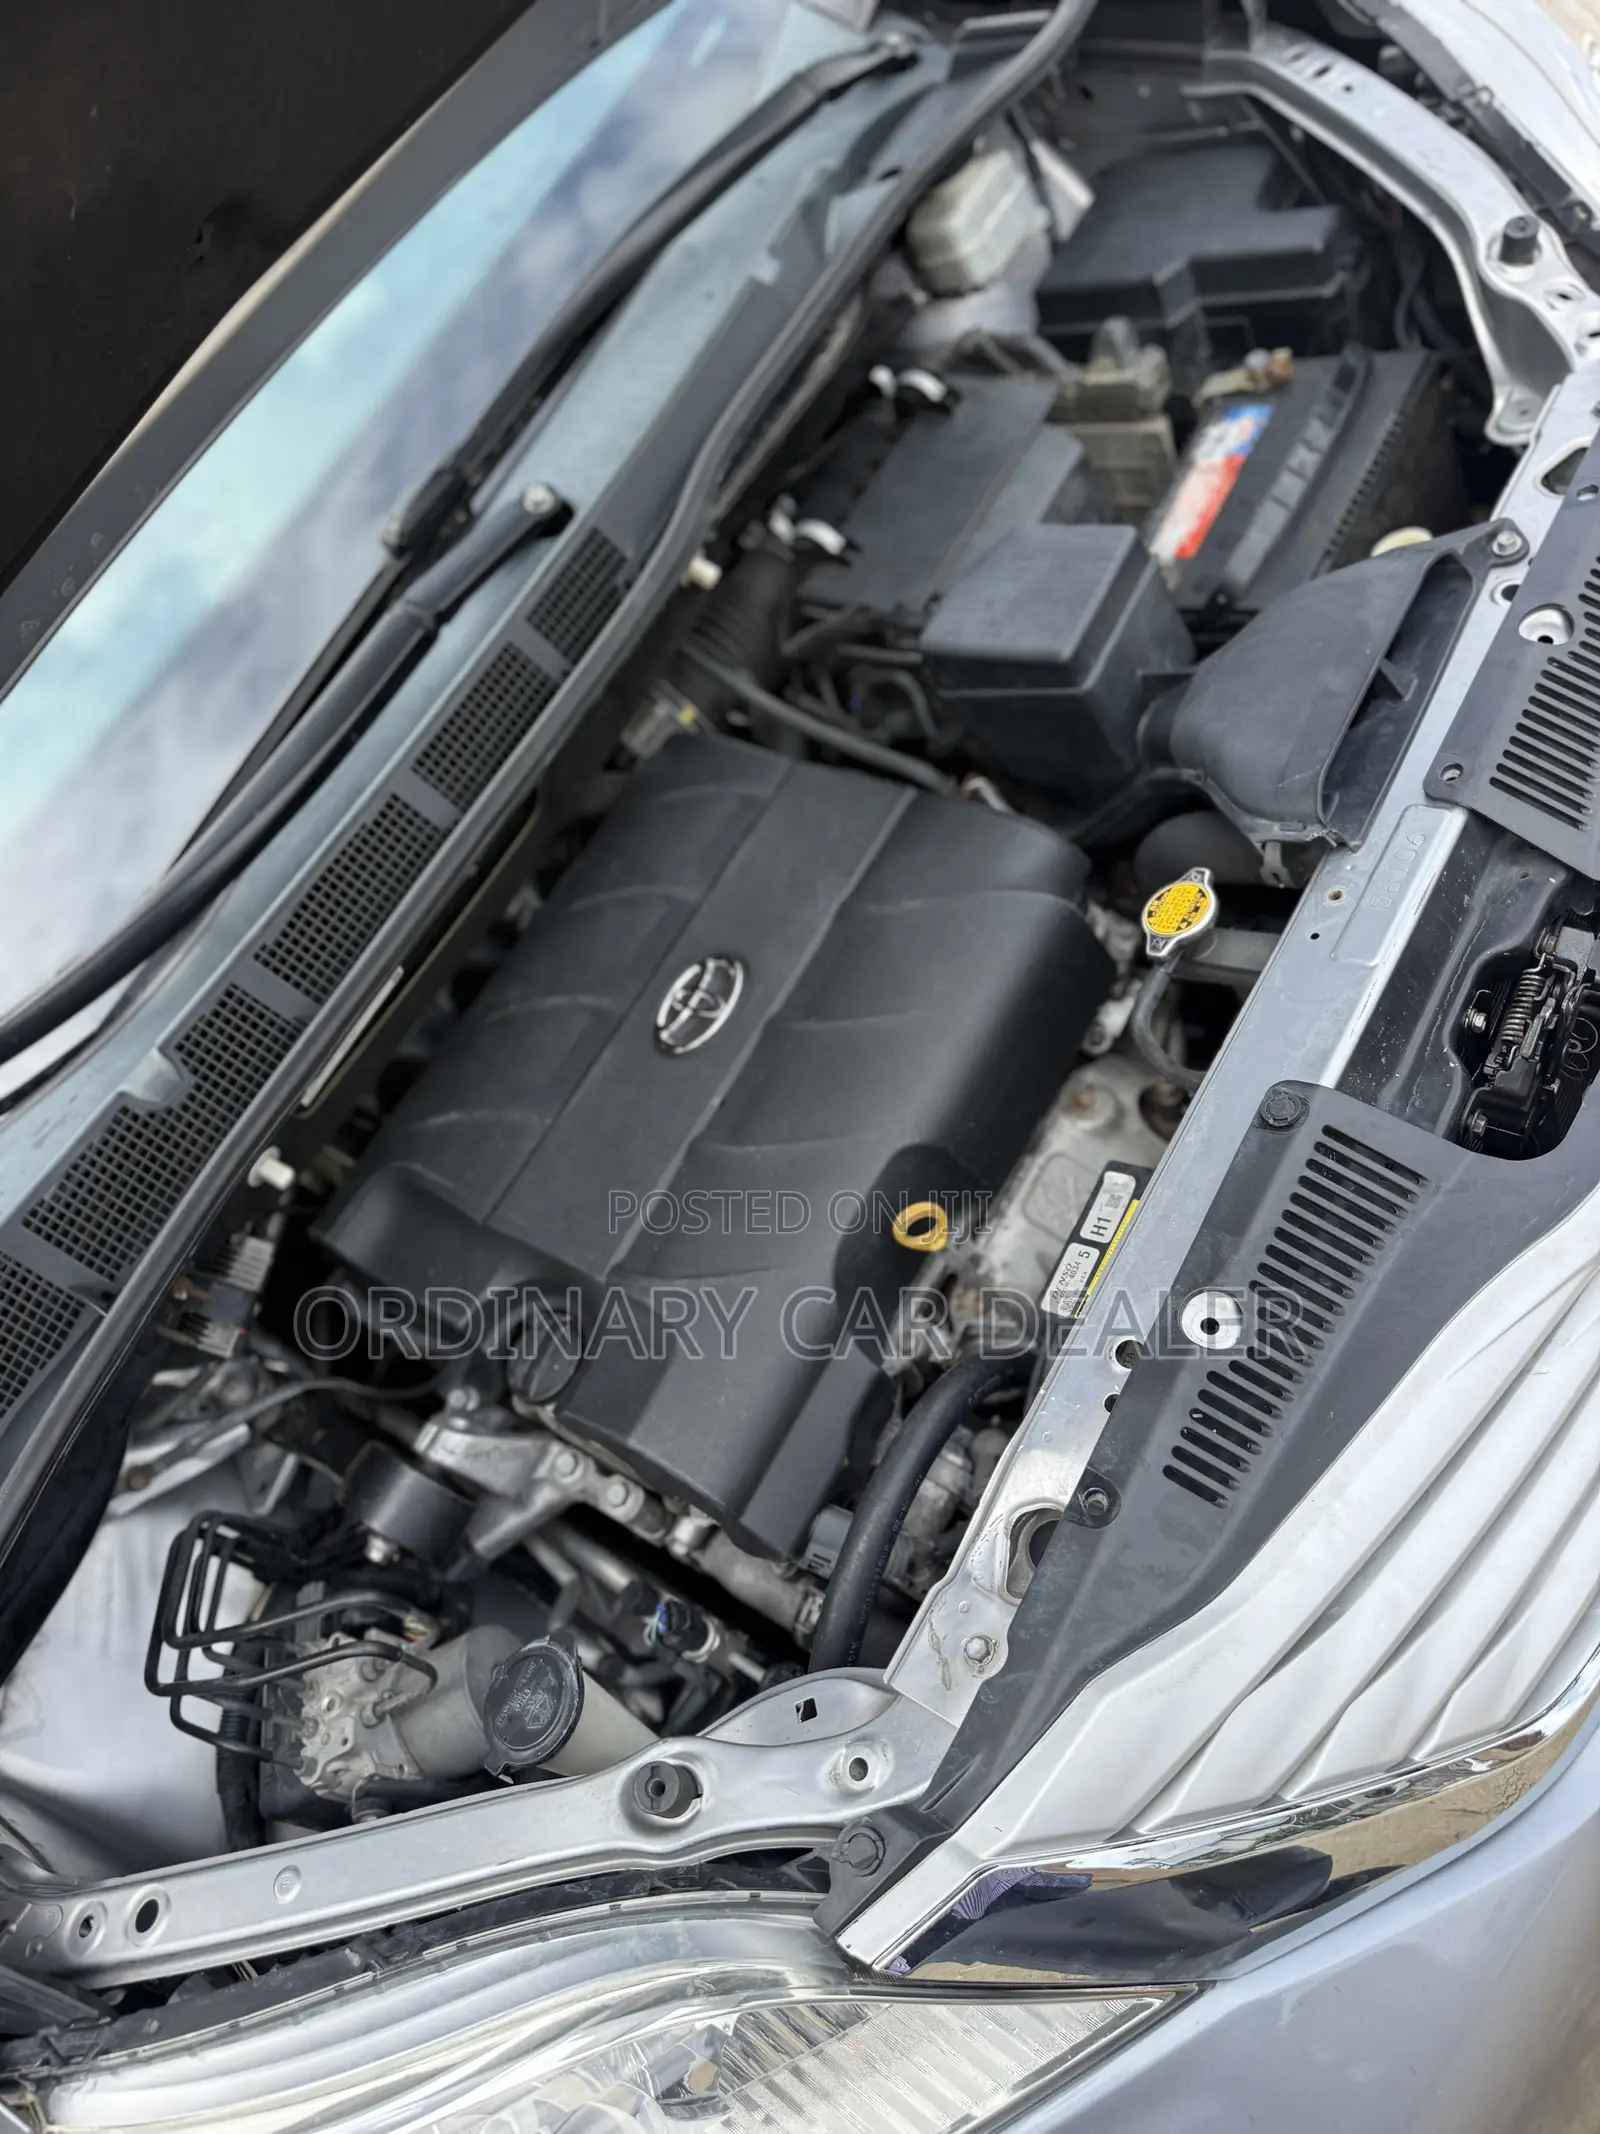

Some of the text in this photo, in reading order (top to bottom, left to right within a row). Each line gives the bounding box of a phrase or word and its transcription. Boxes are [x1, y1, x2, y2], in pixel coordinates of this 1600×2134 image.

[1090, 1216, 1112, 1237] H1
[1078, 1250, 1091, 1259] 5
[1051, 1262, 1073, 1300] DENSO
